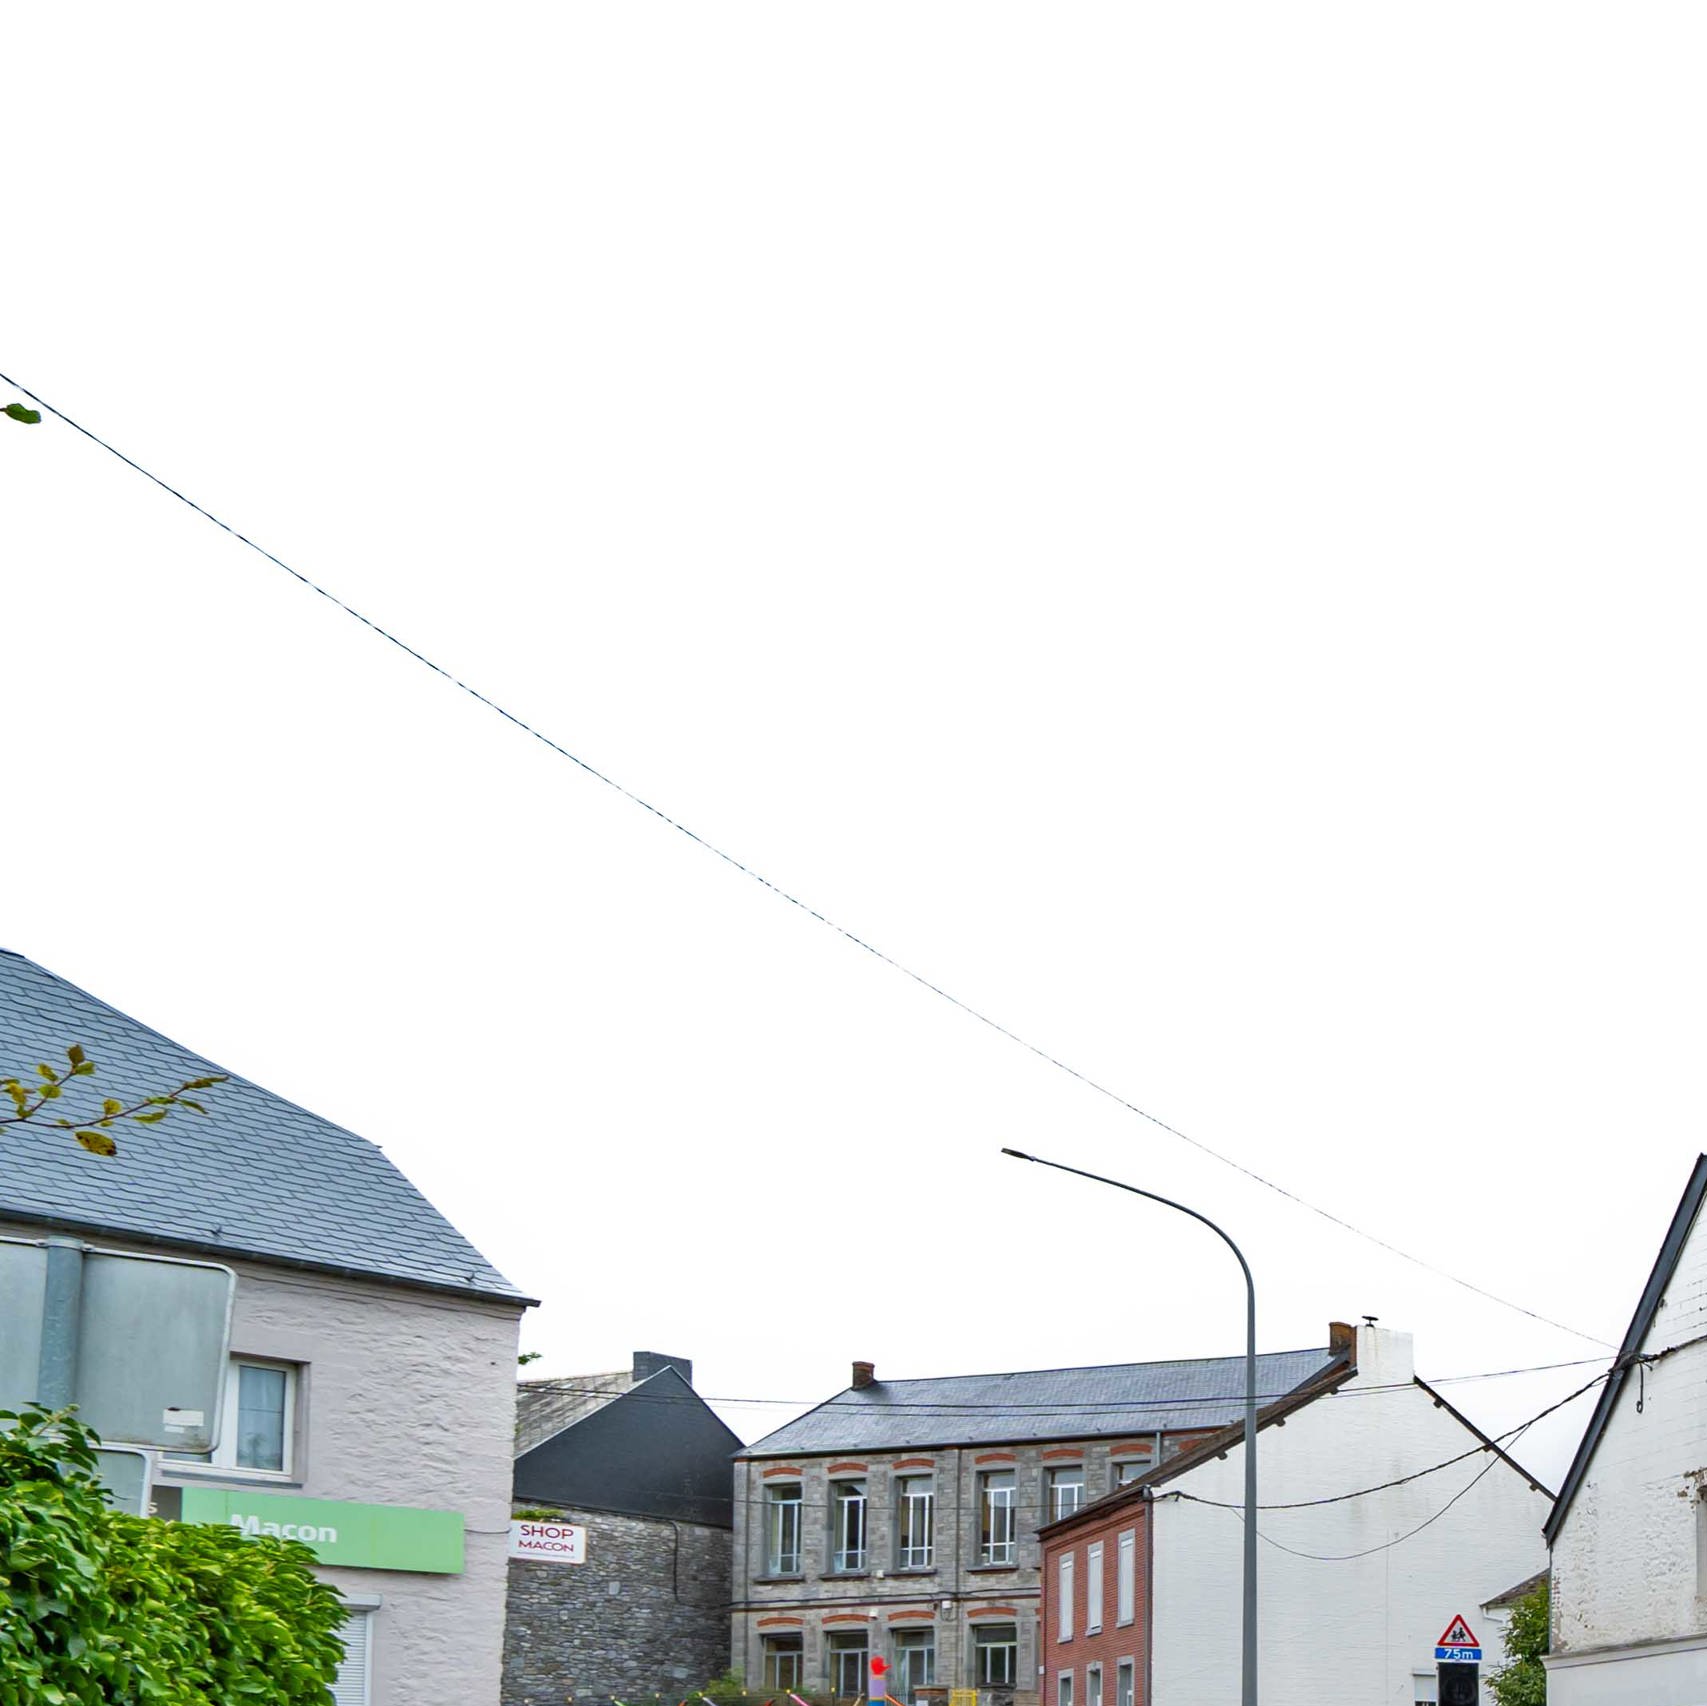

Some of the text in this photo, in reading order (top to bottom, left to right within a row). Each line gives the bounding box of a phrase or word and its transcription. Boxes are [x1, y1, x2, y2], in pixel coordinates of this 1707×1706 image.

[230, 1513, 337, 1543] Macon
[520, 1524, 574, 1539] SHOP
[518, 1540, 574, 1552] MACON
[1444, 1648, 1474, 1660] 75m
